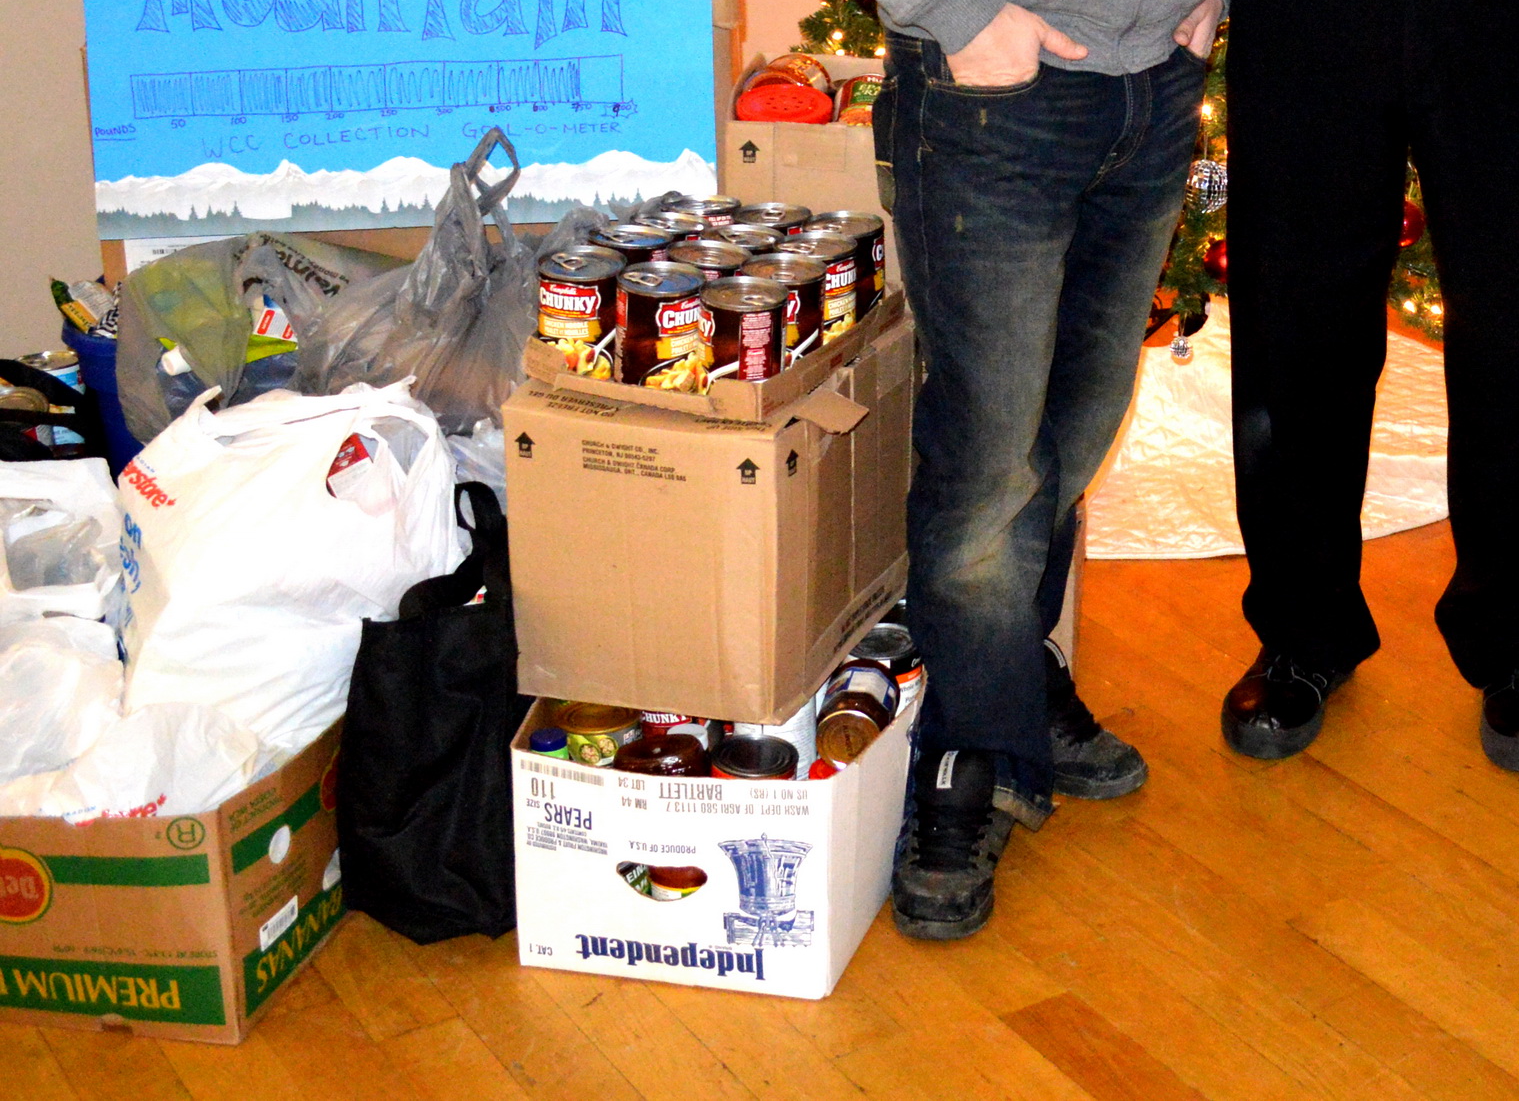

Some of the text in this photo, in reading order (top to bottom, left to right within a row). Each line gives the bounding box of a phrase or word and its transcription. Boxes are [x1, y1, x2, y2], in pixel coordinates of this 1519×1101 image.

[94, 123, 137, 138] POUNDS
[170, 117, 187, 130] 50
[202, 123, 431, 159] WCC COLLECTION
[539, 287, 597, 315] CHUNKY
[581, 439, 605, 449] CHURCH
[531, 777, 556, 801] 110
[617, 776, 645, 791] LOT 34
[658, 782, 723, 801] BARTLETT
[781, 789, 808, 800] US NO
[526, 798, 541, 809] SIZE
[620, 795, 648, 811] RM 44
[700, 802, 810, 816] WASH DEPT OF AGRI 580
[544, 802, 593, 831] PEARS
[649, 843, 697, 855] PRODUCE OF
[256, 886, 343, 992] BANANAS
[534, 943, 554, 956] CAT.
[575, 933, 766, 981] Independent
[12, 968, 181, 1010] PREMIUM
